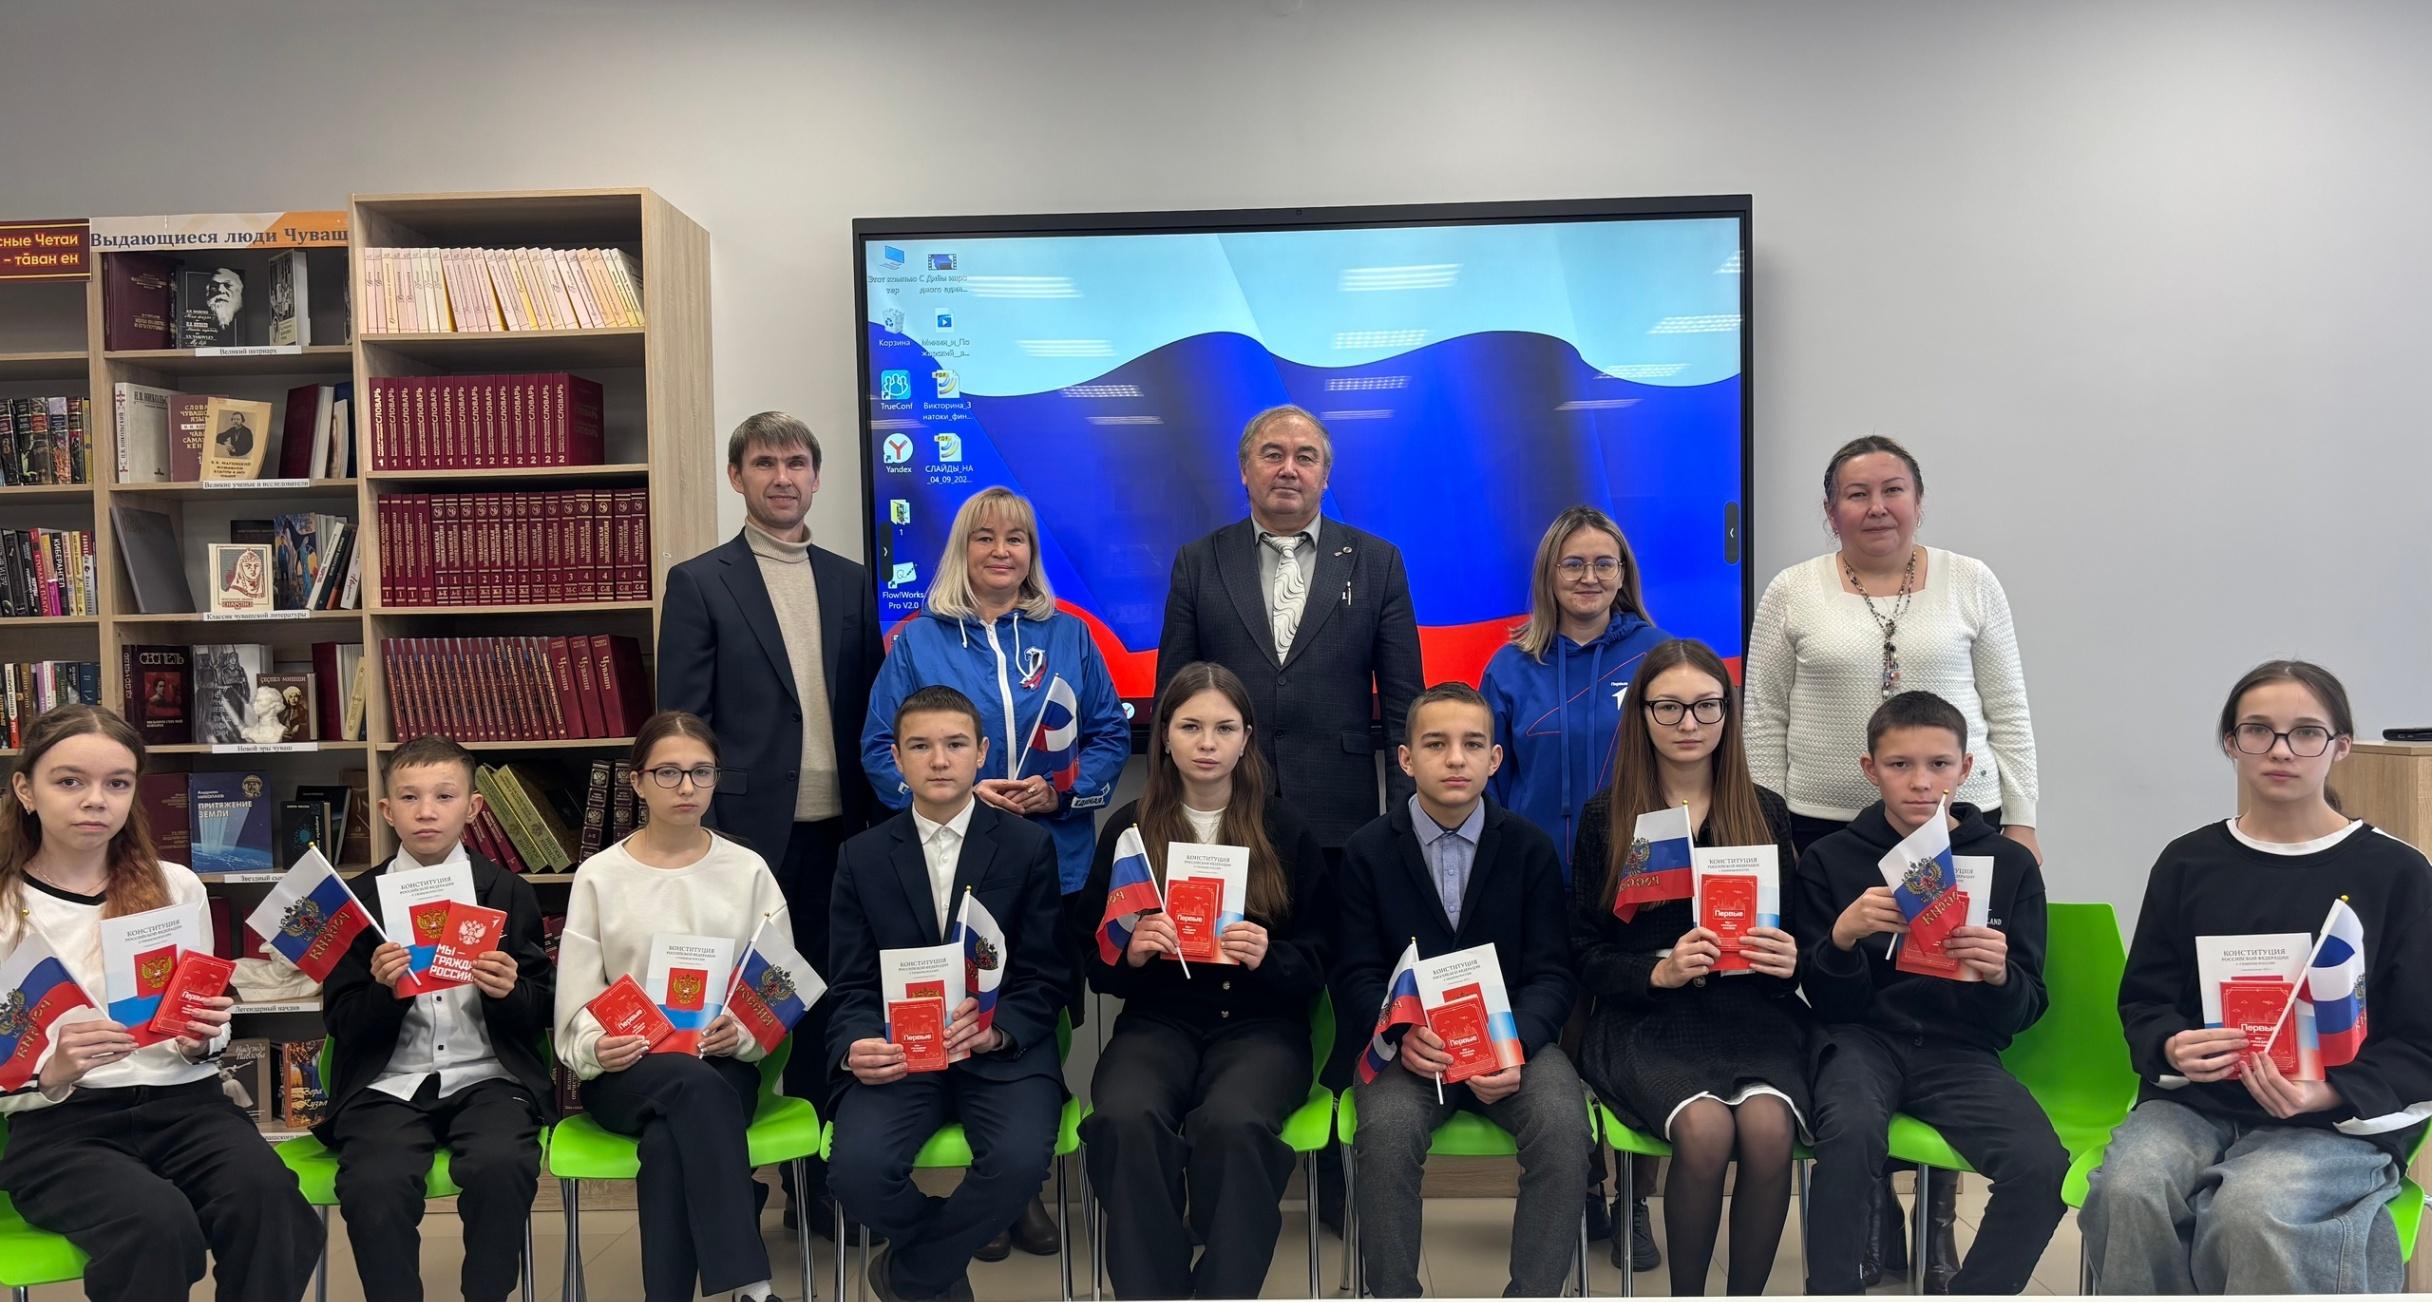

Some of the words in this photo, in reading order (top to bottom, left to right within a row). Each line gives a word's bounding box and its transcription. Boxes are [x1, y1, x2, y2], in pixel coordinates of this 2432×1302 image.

[35, 234, 78, 246] Четаи
[91, 231, 218, 248] Выдающиеся
[224, 231, 277, 245] люди
[61, 254, 78, 264] ен
[374, 387, 383, 423] СЛОВАРЬ
[388, 387, 396, 423] СЛОВАРЬ
[402, 387, 410, 423] СЛОВАРЬ
[416, 387, 424, 423] СЛОВАРЬ
[430, 387, 439, 422] СЛОВАРЬ
[443, 387, 451, 422] СЛОВАРЬ
[458, 387, 466, 422] СЛОВАРЬ
[471, 386, 479, 422] СЛОВАРЬ
[485, 386, 493, 421] СЛОВАРЬ
[500, 386, 508, 421] СЛОВАРЬ
[542, 385, 550, 420] СЛОВАРЬ
[557, 384, 565, 420] СЛОВАРЬ
[881, 402, 913, 410] TrueConf
[379, 459, 384, 467] 1
[392, 459, 397, 467] 1
[448, 458, 453, 466] 1
[475, 457, 482, 465] 2
[489, 457, 495, 465] 2
[530, 456, 537, 464] 2
[886, 465, 912, 473] Yandex
[925, 464, 974, 474] СЛАЙДЫ_НА
[53, 538, 65, 588] КИБЕРАНГЕЛ
[440, 576, 444, 584] 1
[453, 576, 457, 584] 1
[495, 575, 499, 583] 2
[537, 574, 541, 582] 3
[553, 573, 557, 581] 3
[569, 573, 573, 581] 3
[622, 571, 626, 579] 4
[888, 602, 902, 610] Pro
[903, 602, 919, 610] V2.0
[198, 801, 252, 810] ПРИТЯЖЕНИЕ
[199, 810, 229, 818] ЗЕМЛИ
[400, 877, 451, 890] КОНСТИТУЦИЯ
[1714, 909, 1744, 917] Первые
[1177, 915, 1203, 923] Первые
[127, 920, 180, 937] КОНСТИТУЦИЯ
[437, 944, 456, 956] МЫ
[900, 958, 947, 967] КОНСТИТУЦИЯ
[1433, 960, 1478, 975] КОНСТИТУЦИЯ
[235, 1006, 276, 1014] Легендарный
[736, 984, 774, 1026] РОССИЯ
[618, 1009, 643, 1030] Первые
[904, 1034, 932, 1042] Первые
[1449, 1035, 1478, 1047] Первые
